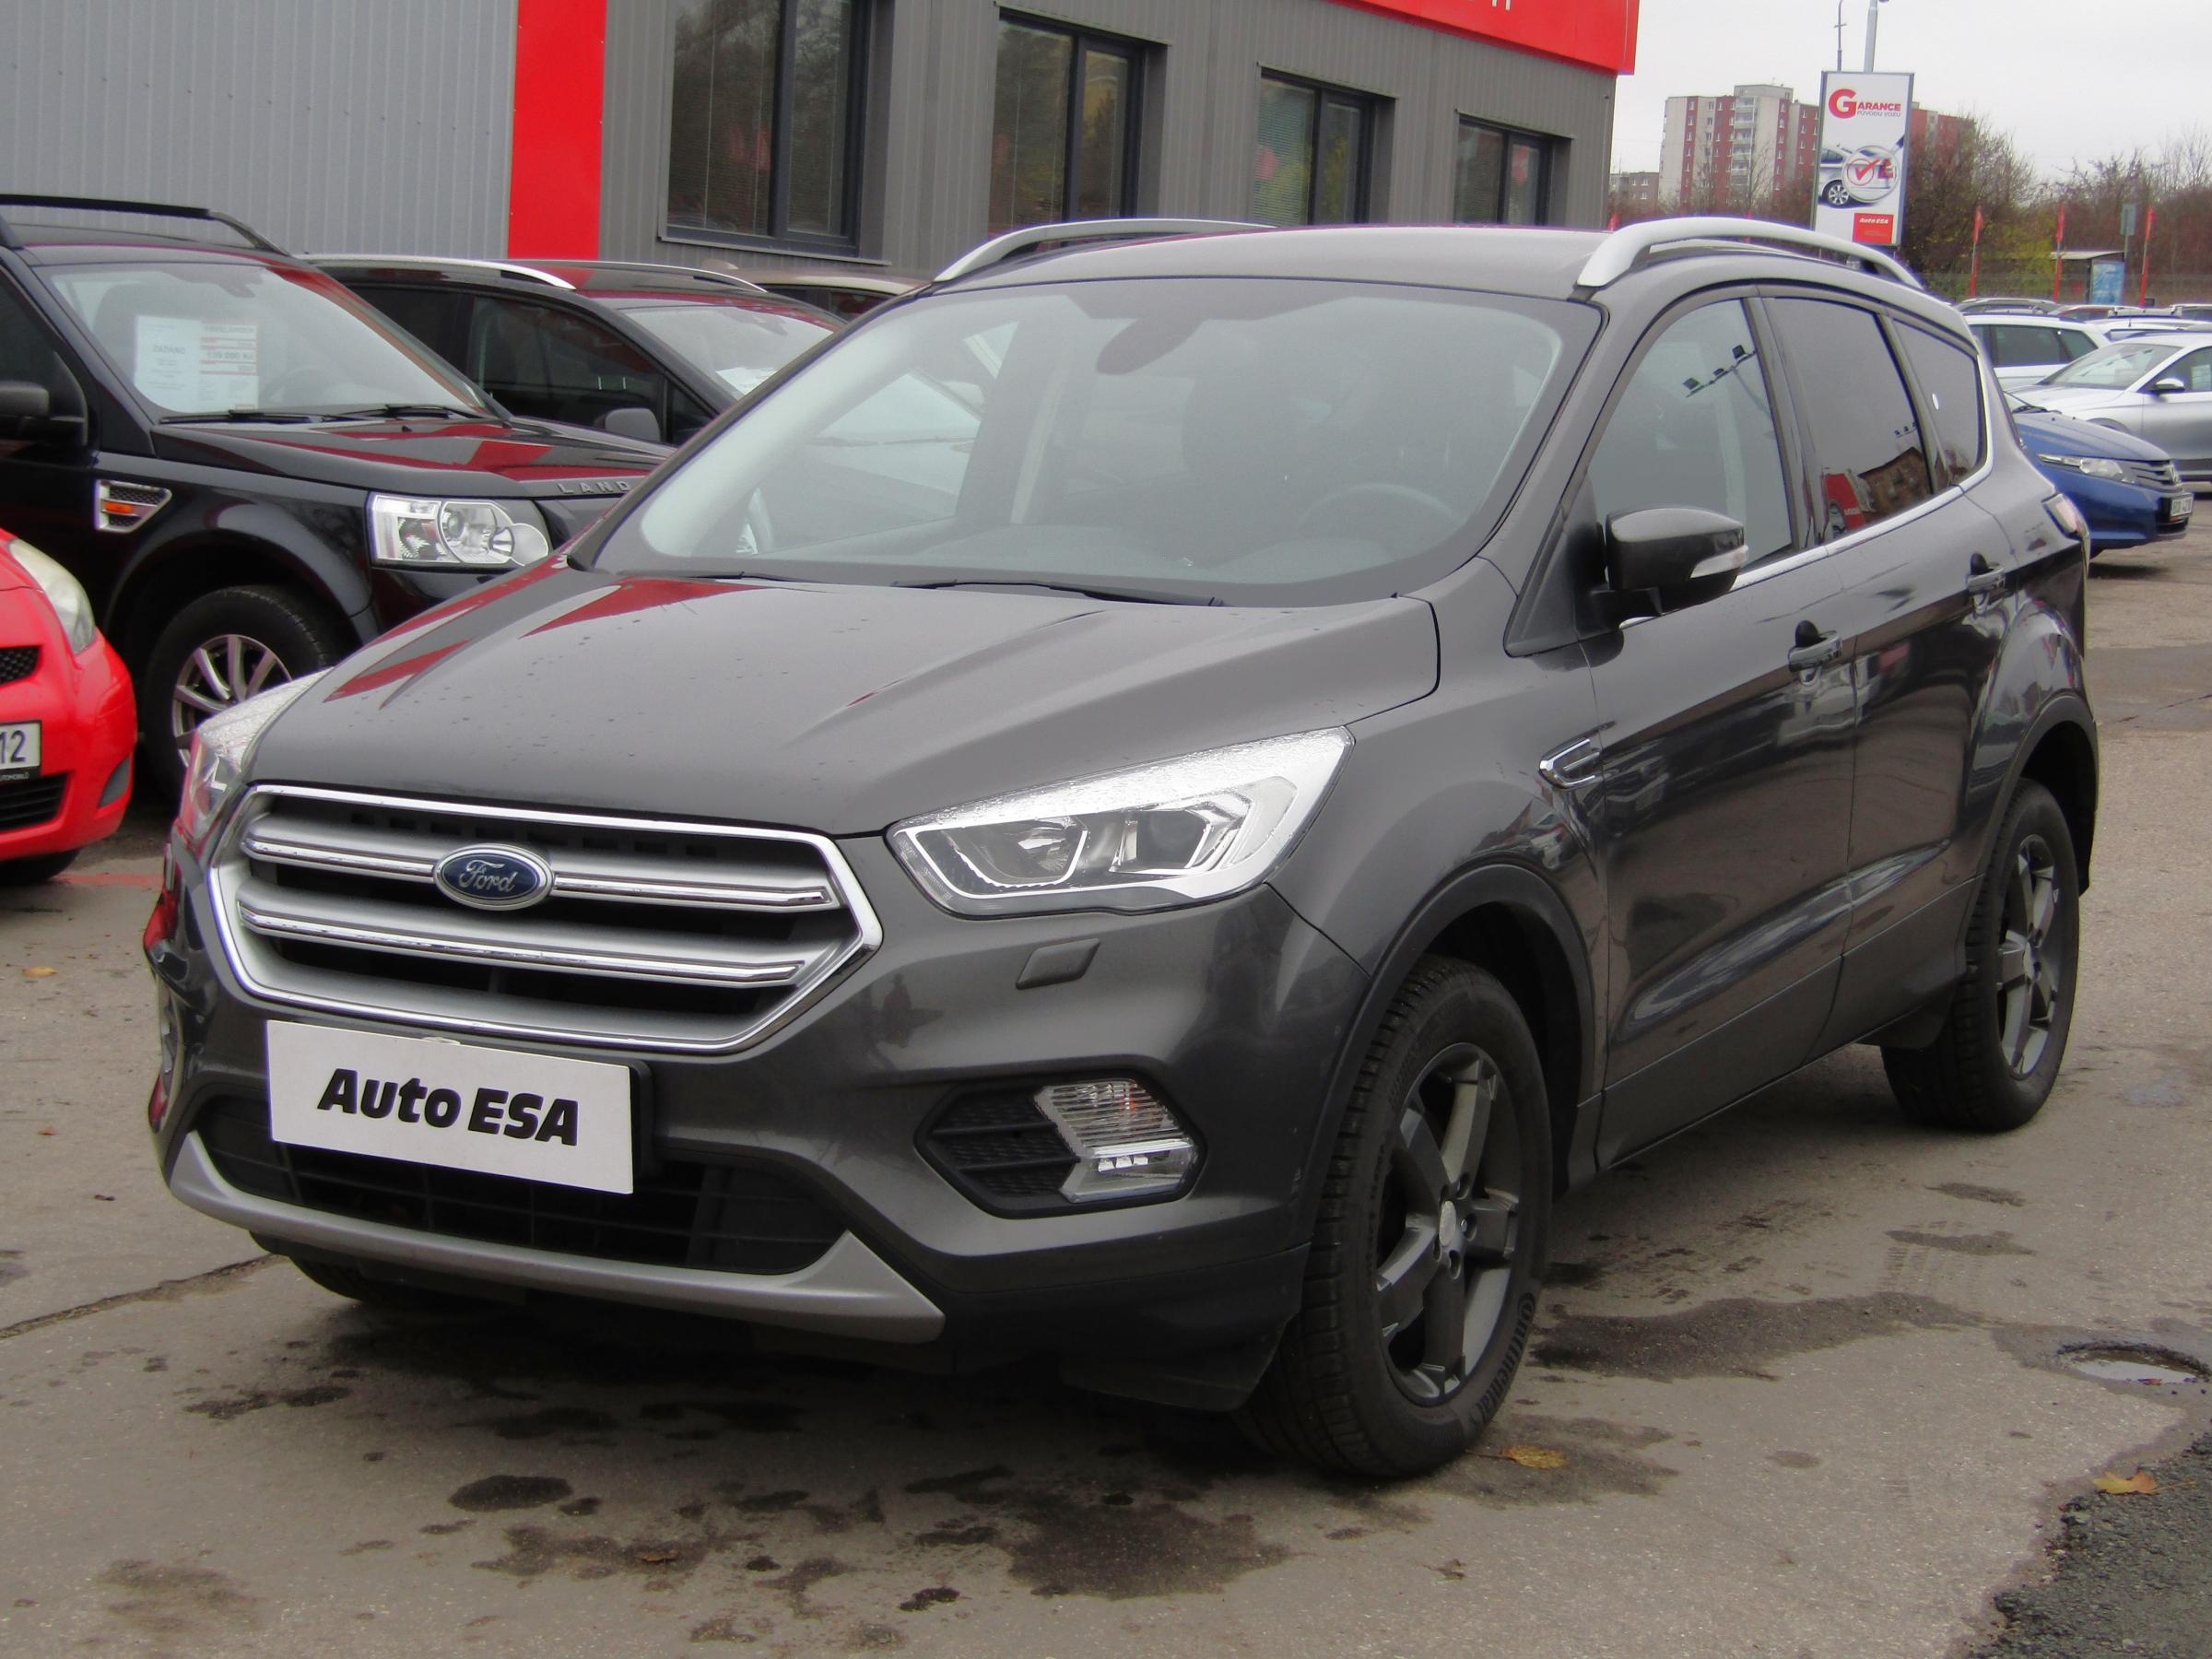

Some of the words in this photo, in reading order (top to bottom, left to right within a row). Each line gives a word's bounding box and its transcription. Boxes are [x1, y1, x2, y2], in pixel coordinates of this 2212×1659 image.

[1829, 88, 1900, 119] GARANCE
[557, 480, 631, 494] LAND
[459, 859, 518, 892] Ford
[317, 1068, 461, 1127] Auto
[468, 1088, 579, 1146] ESA
